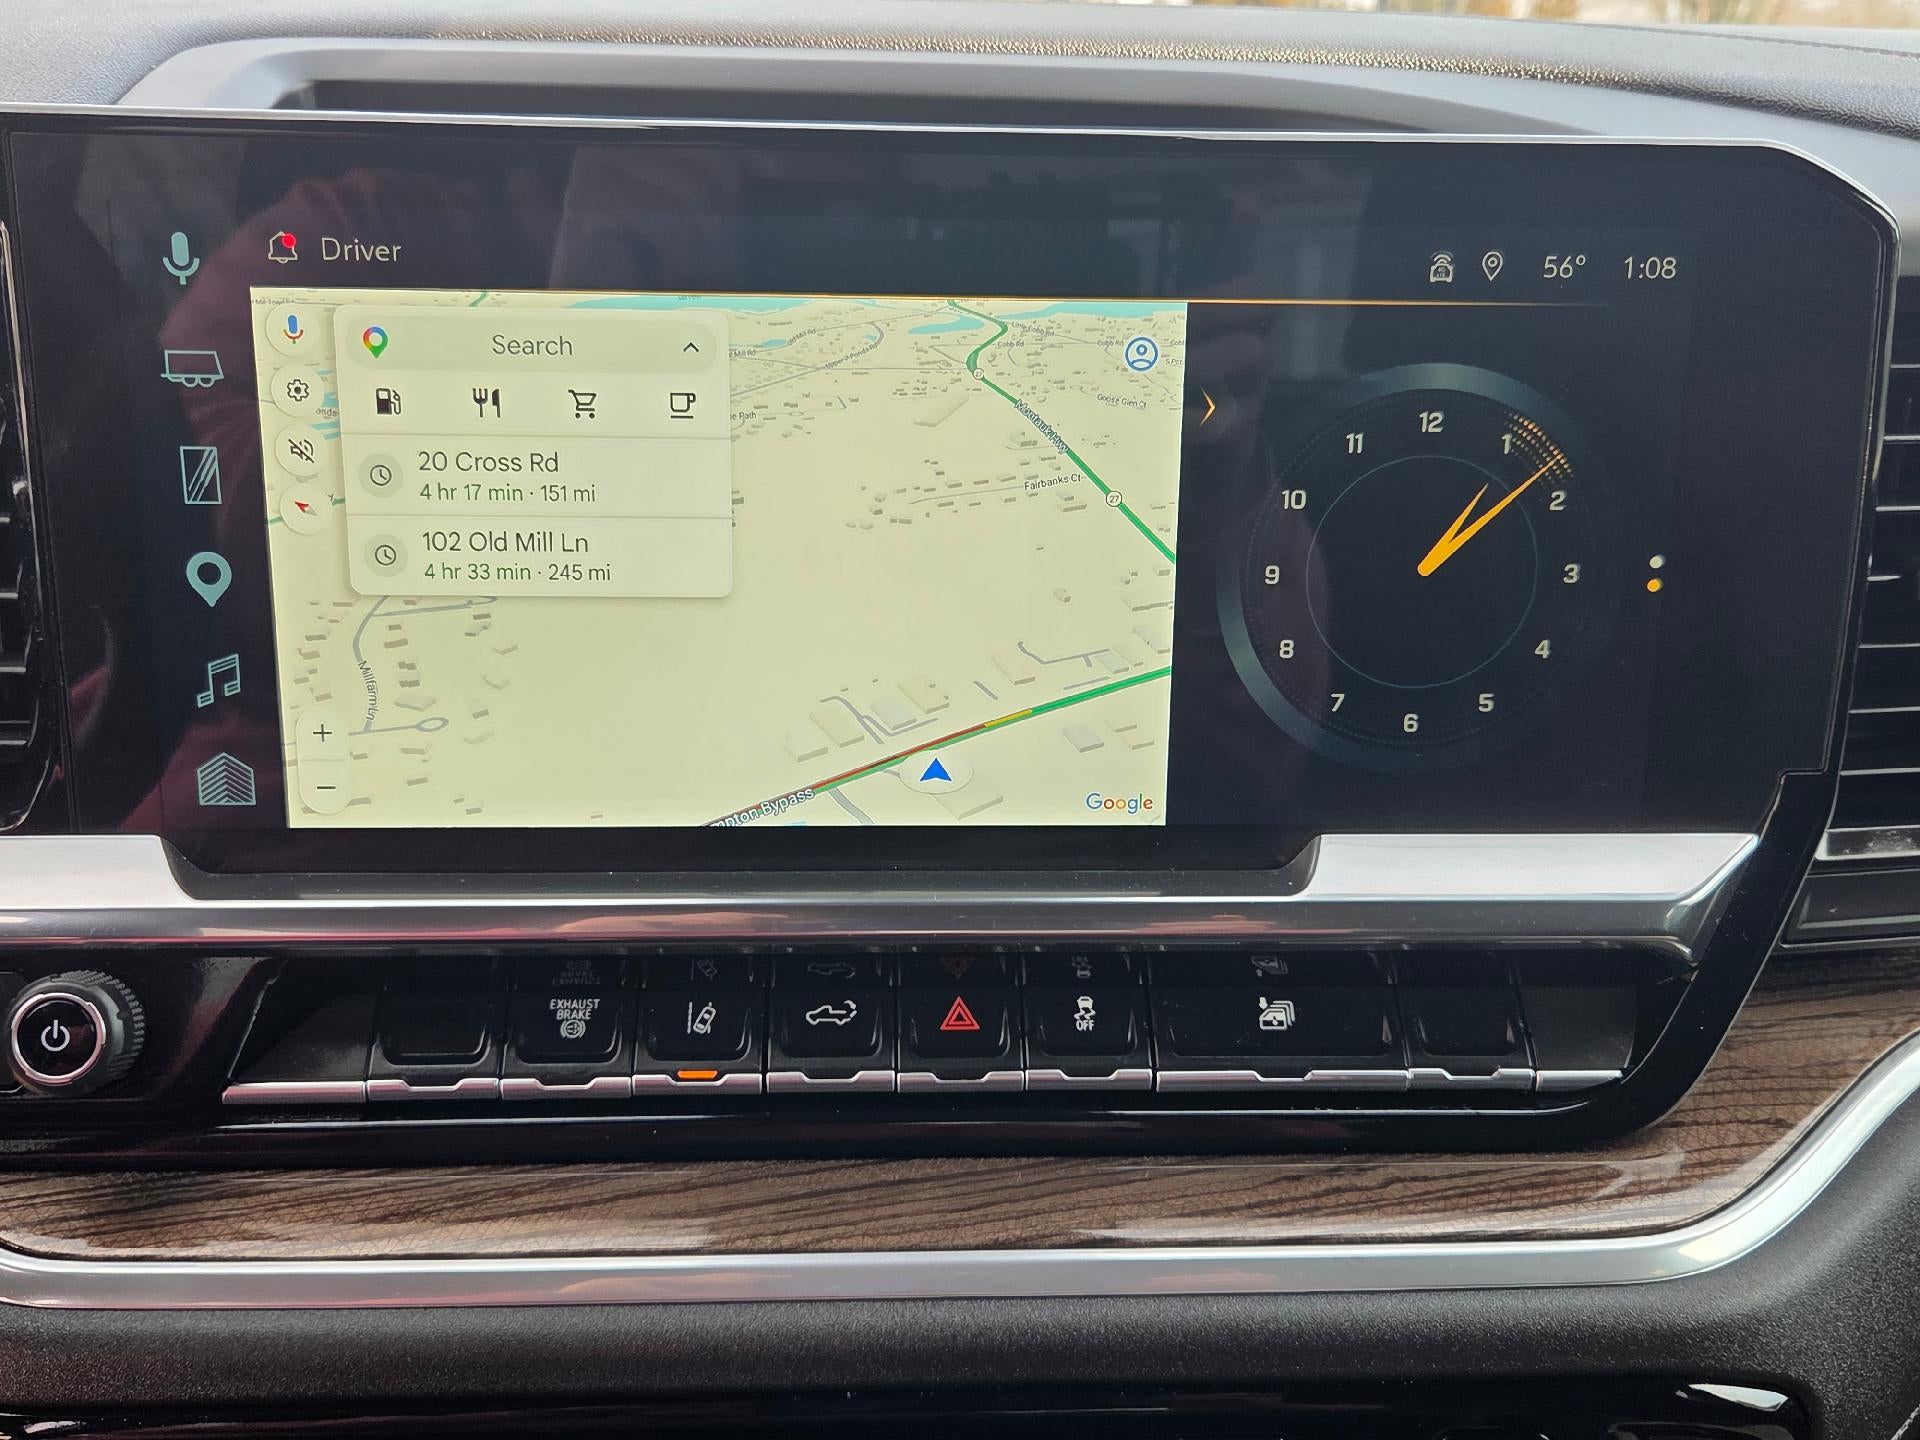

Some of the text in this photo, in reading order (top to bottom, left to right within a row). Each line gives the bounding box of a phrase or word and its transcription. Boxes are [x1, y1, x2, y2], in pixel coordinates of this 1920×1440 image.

[321, 237, 402, 263] Driver
[1543, 254, 1586, 279] 56°
[1624, 256, 1677, 280] 1:08
[492, 335, 574, 357] Search
[1097, 393, 1147, 409] Goose Glen Ct
[739, 411, 757, 420] Path
[1014, 398, 1070, 454] Montauk Hwy
[1419, 411, 1445, 434] 12
[1346, 433, 1365, 455] 11
[1501, 433, 1512, 455] 1
[418, 451, 559, 473] 20 Cross Rd
[420, 482, 596, 502] 4 hr 17 min 151 mi
[1024, 473, 1081, 491] Fairbanks Ct
[1109, 495, 1119, 504] 27
[1282, 489, 1308, 510] 10
[1549, 490, 1567, 511] 2
[422, 531, 589, 552] 102 Old Mill Ln
[424, 562, 611, 581] 4 hr 33 min 245 mi
[1264, 564, 1281, 585] 9
[1562, 563, 1581, 584] 3
[1279, 639, 1296, 660] 8
[1534, 639, 1552, 660] 4
[358, 660, 379, 721] Millfarm Ln
[1331, 693, 1346, 713] 7
[1478, 693, 1495, 713] 5
[1403, 713, 1420, 733] 6
[760, 788, 815, 816] Bypass
[1086, 793, 1153, 814] Google
[549, 998, 601, 1010] EXHAUST
[556, 1008, 592, 1020] BRAKE
[1075, 1019, 1095, 1031] OFF
